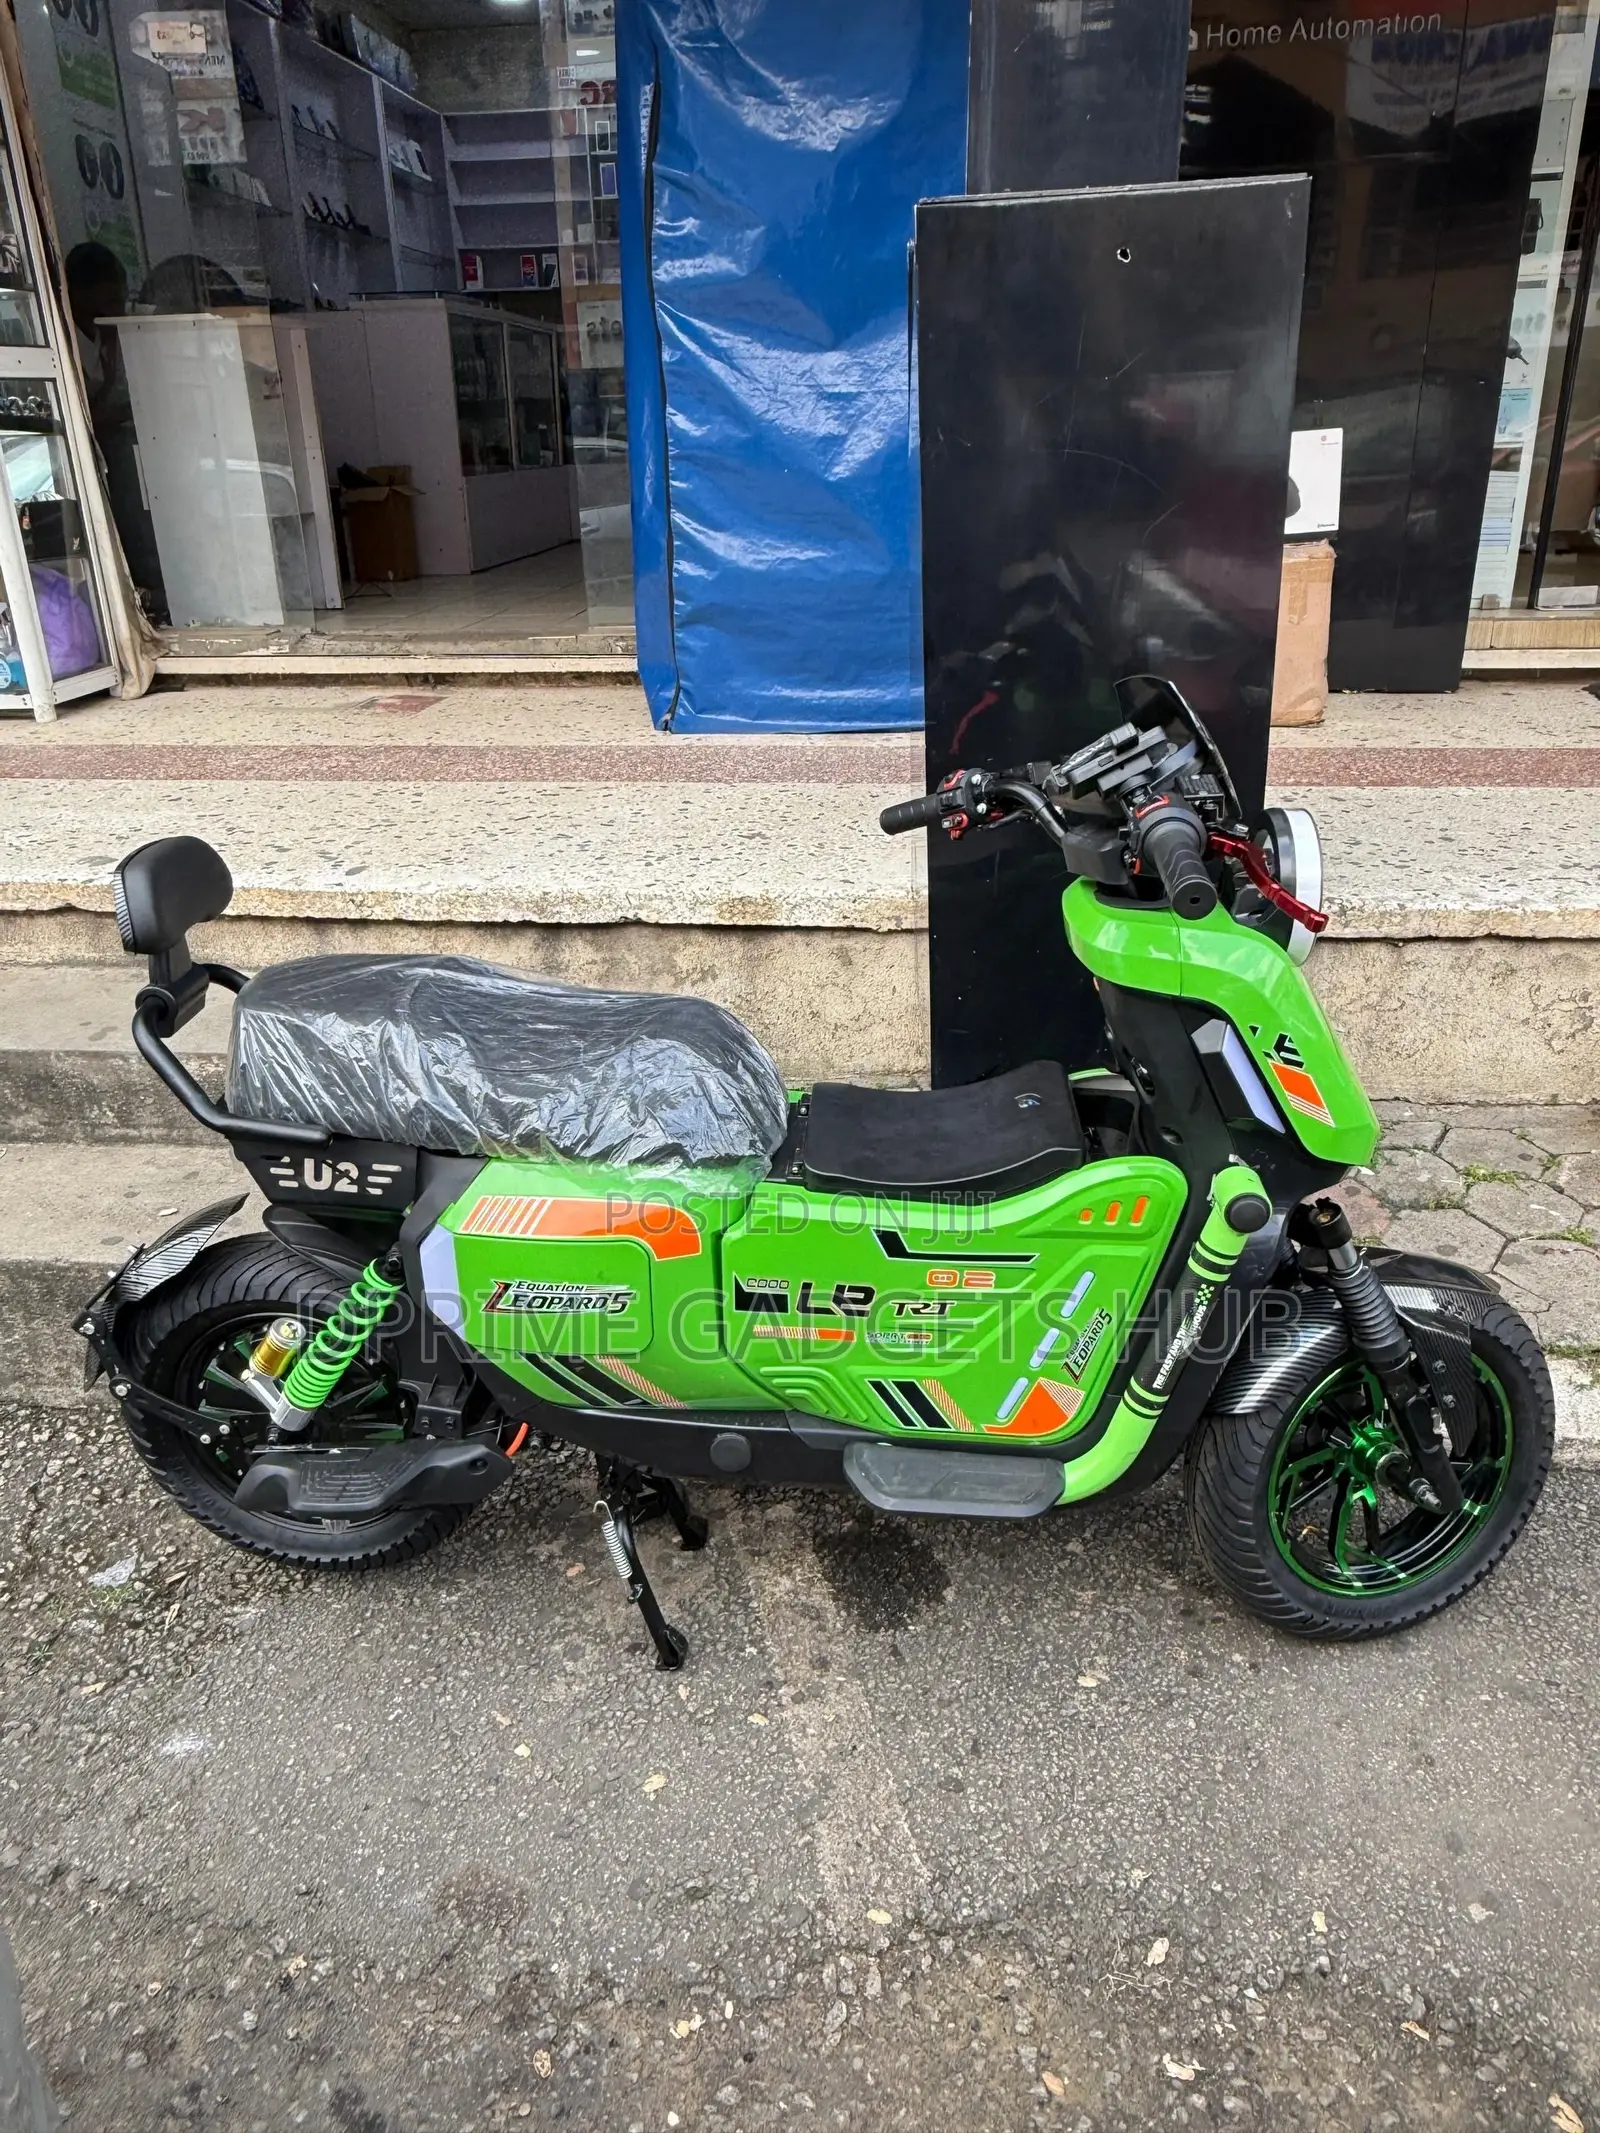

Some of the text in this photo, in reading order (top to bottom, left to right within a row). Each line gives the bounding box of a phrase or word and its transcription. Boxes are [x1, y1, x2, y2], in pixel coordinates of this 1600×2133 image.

[1206, 13, 1441, 50] Home Automation
[303, 1157, 359, 1193] U2
